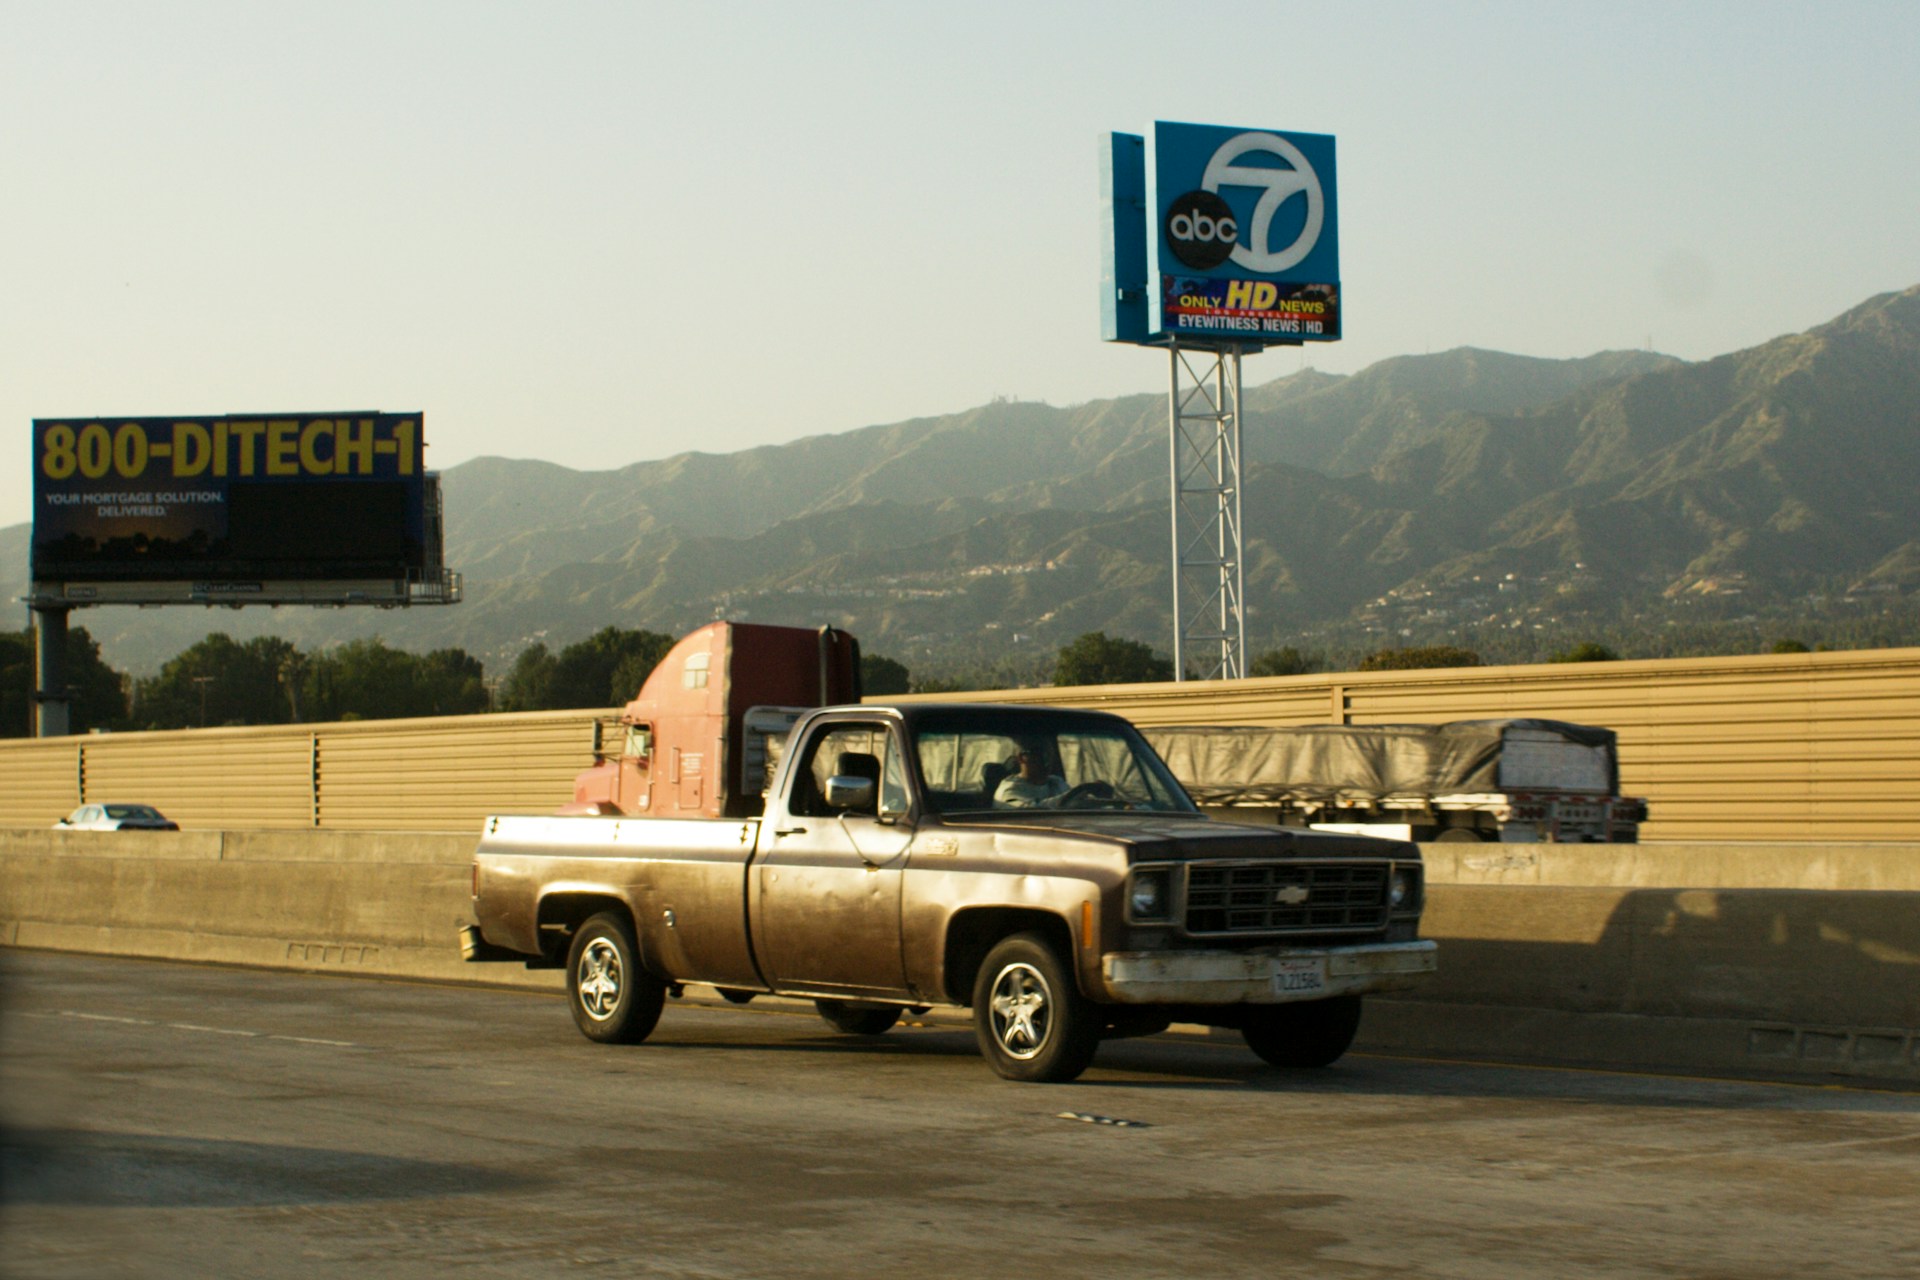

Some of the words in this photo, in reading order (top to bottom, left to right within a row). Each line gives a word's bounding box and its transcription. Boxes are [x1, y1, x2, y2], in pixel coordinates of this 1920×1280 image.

[1170, 208, 1238, 243] abc
[1180, 295, 1221, 308] ONLY
[1225, 279, 1278, 310] HD
[1279, 300, 1325, 314] NEWS
[1178, 313, 1260, 331] EYEWITNESS
[1262, 318, 1300, 333] NEWS
[1306, 320, 1324, 334] HD
[1206, 308, 1229, 316] LOS
[1239, 310, 1299, 319] ANGELES
[42, 420, 415, 480] 800-DITECH-1
[46, 493, 80, 505] YOUR
[83, 492, 153, 504] MORTGAGE
[155, 491, 224, 503] SOLUTION.
